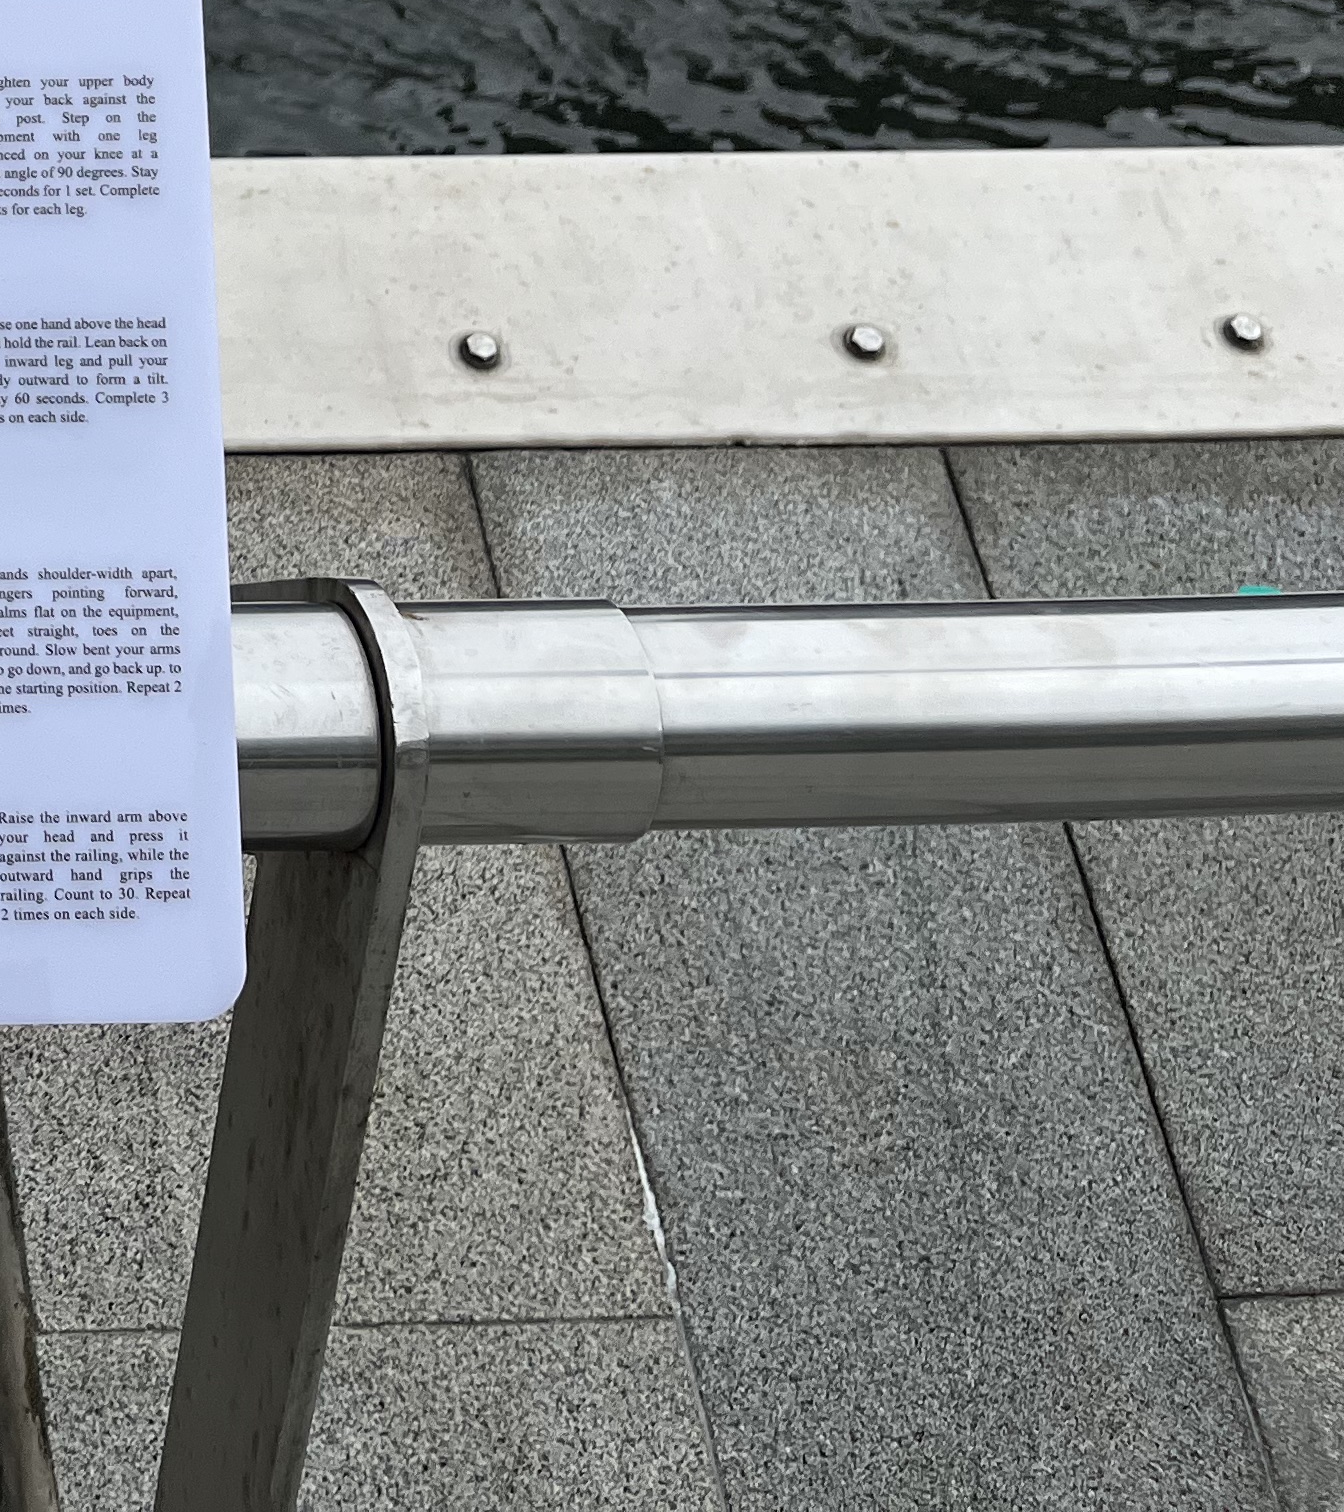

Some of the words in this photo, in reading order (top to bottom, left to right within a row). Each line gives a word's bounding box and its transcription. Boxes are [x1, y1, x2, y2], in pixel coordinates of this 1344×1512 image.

[15, 113, 46, 128] post.
[61, 111, 90, 127] Step
[105, 114, 122, 124] on
[136, 110, 157, 123] the
[14, 391, 31, 405] 60
[35, 391, 90, 405] seconds.
[94, 390, 156, 408] Complete
[161, 390, 170, 404] 3
[37, 566, 134, 581] shoulder-width
[141, 568, 178, 583] apart,
[33, 605, 56, 619] flat
[60, 608, 77, 618] on
[82, 604, 103, 618] the
[108, 604, 180, 621] equipment,
[0, 868, 54, 883] outward
[70, 867, 103, 882] hand
[119, 870, 153, 884] grips
[169, 866, 191, 880] the
[0, 907, 9, 921] 2
[13, 907, 50, 921] times
[53, 910, 71, 921] on
[74, 906, 106, 920] each
[108, 906, 140, 920] side.
